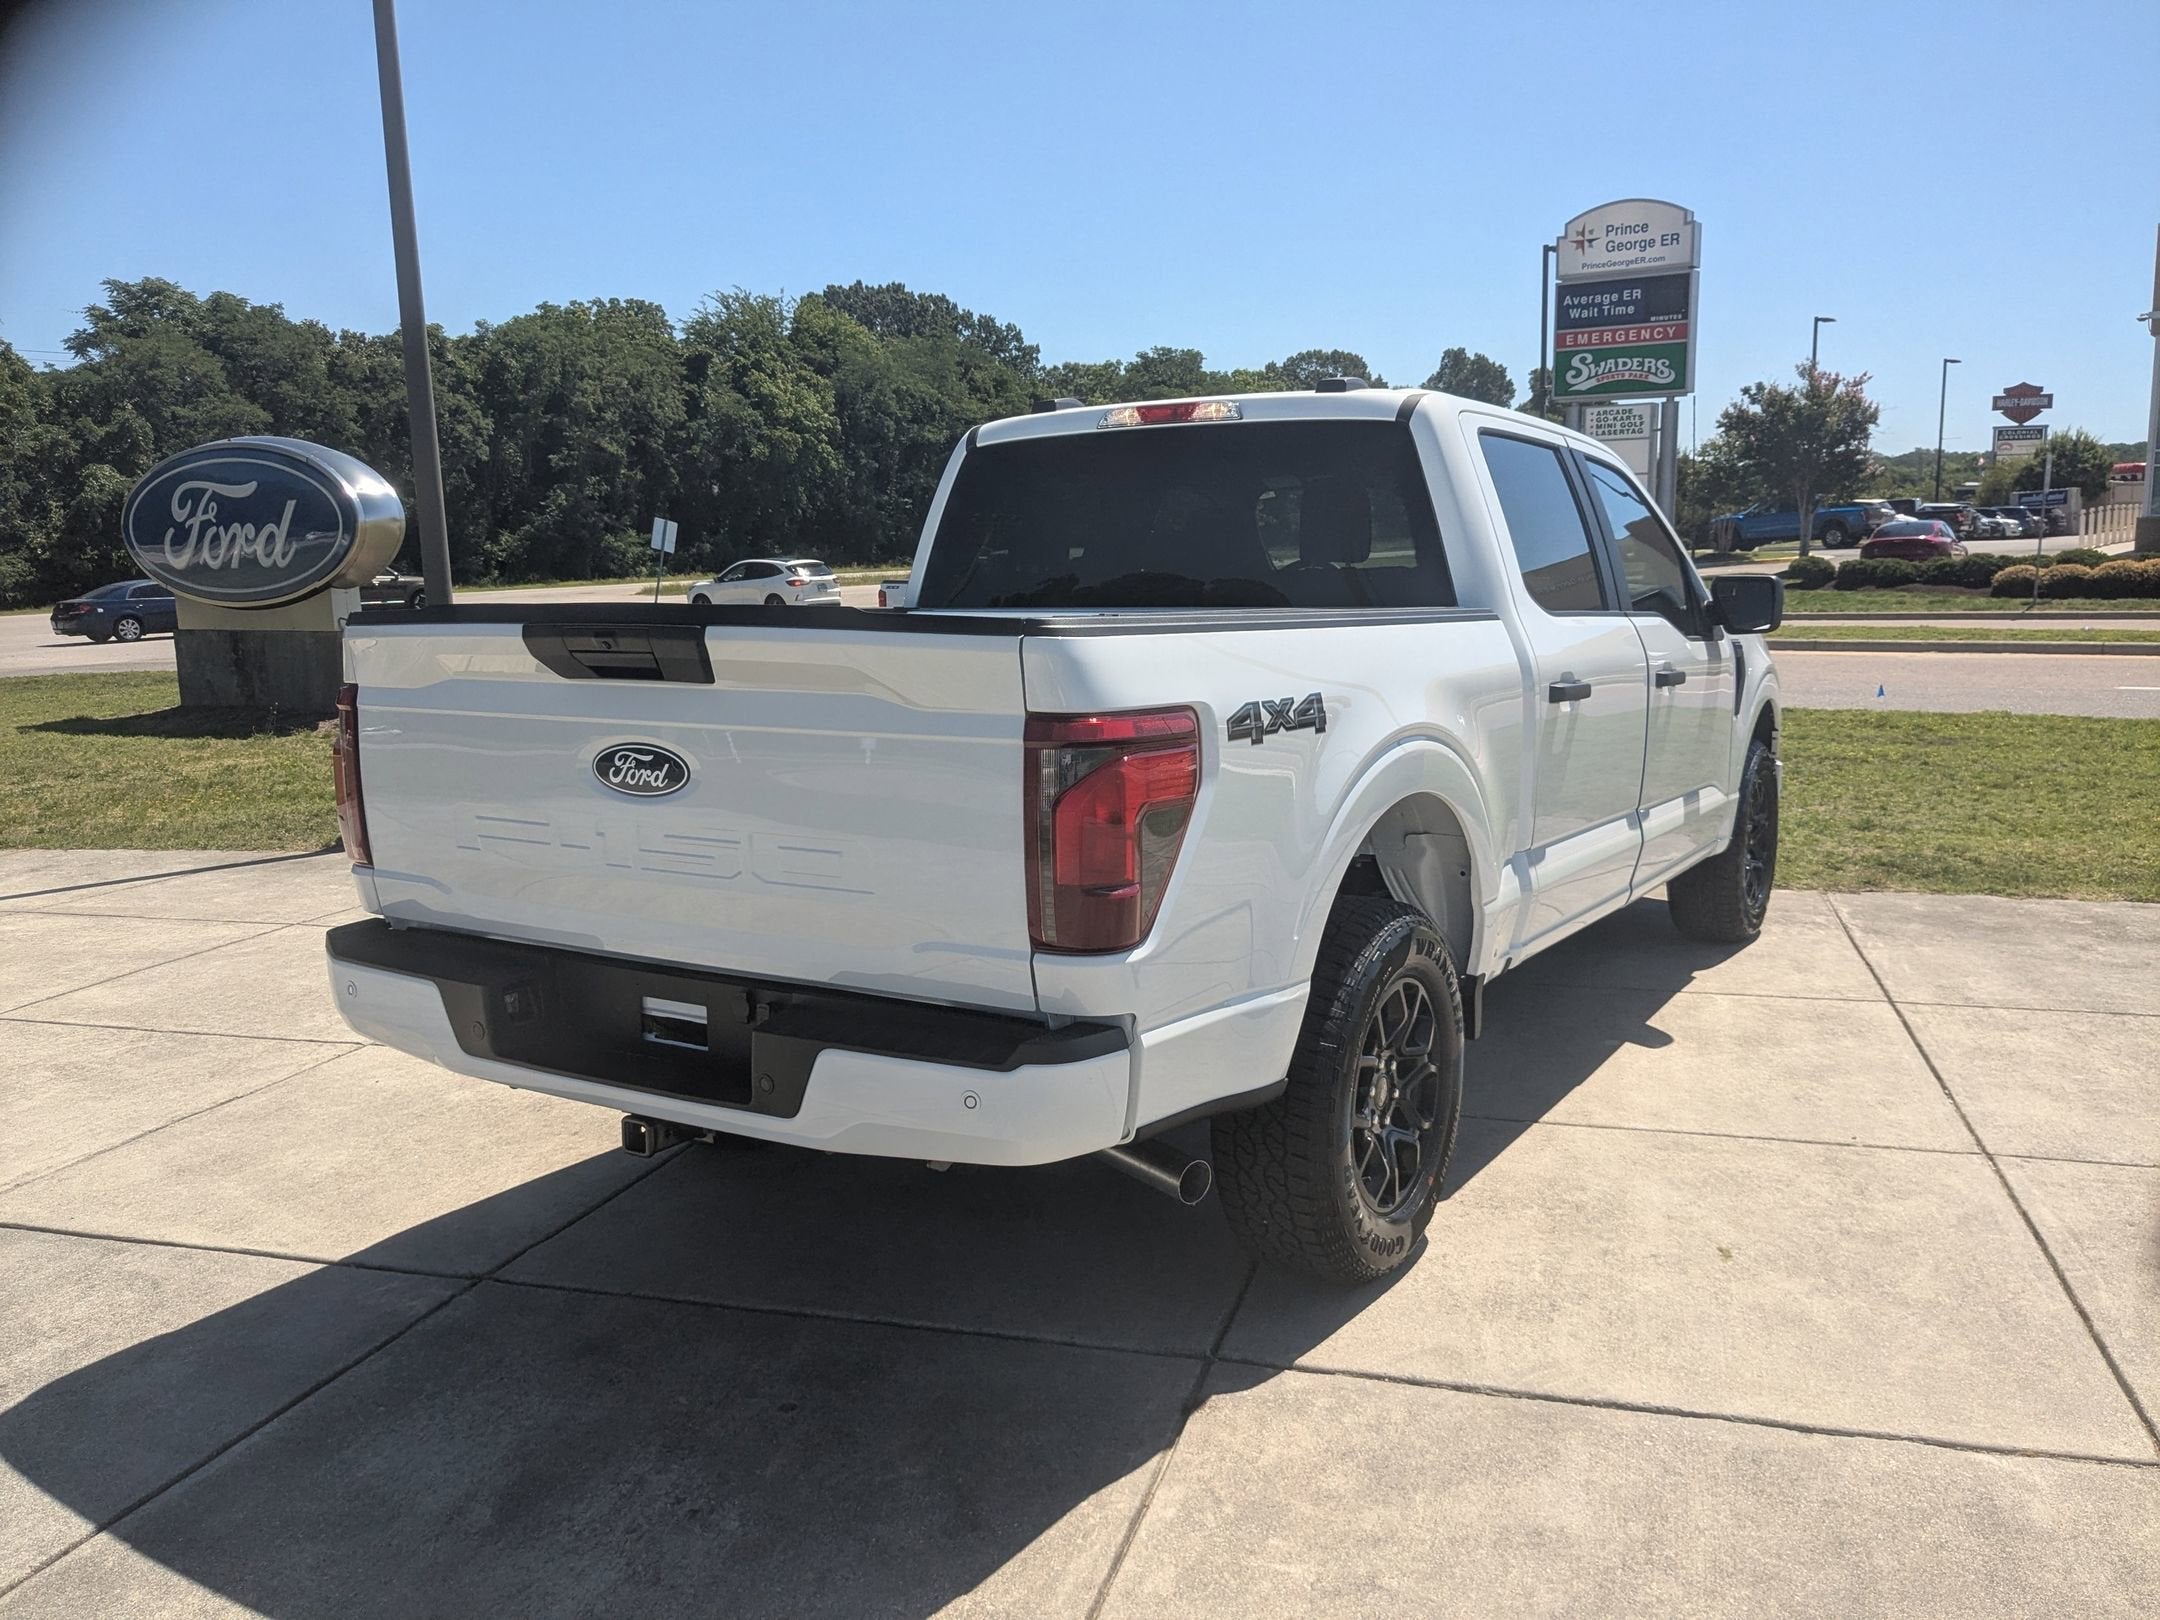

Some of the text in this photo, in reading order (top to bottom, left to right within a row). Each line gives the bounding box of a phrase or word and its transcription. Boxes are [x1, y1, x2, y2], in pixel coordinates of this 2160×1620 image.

[1605, 222, 1649, 237] Prince
[1605, 232, 1680, 253] George ER
[1581, 255, 1666, 270] PrinceGeorgeER.com
[1563, 289, 1642, 306] Average ER
[1569, 303, 1635, 319] Wait Time
[1566, 326, 1677, 346] EMERGENCY
[1595, 408, 1634, 417] ARCADE
[1595, 414, 1644, 423] GO-KARTS
[1595, 420, 1645, 430] MINI GOLF
[164, 480, 297, 570] Ford
[609, 751, 670, 788] Ford
